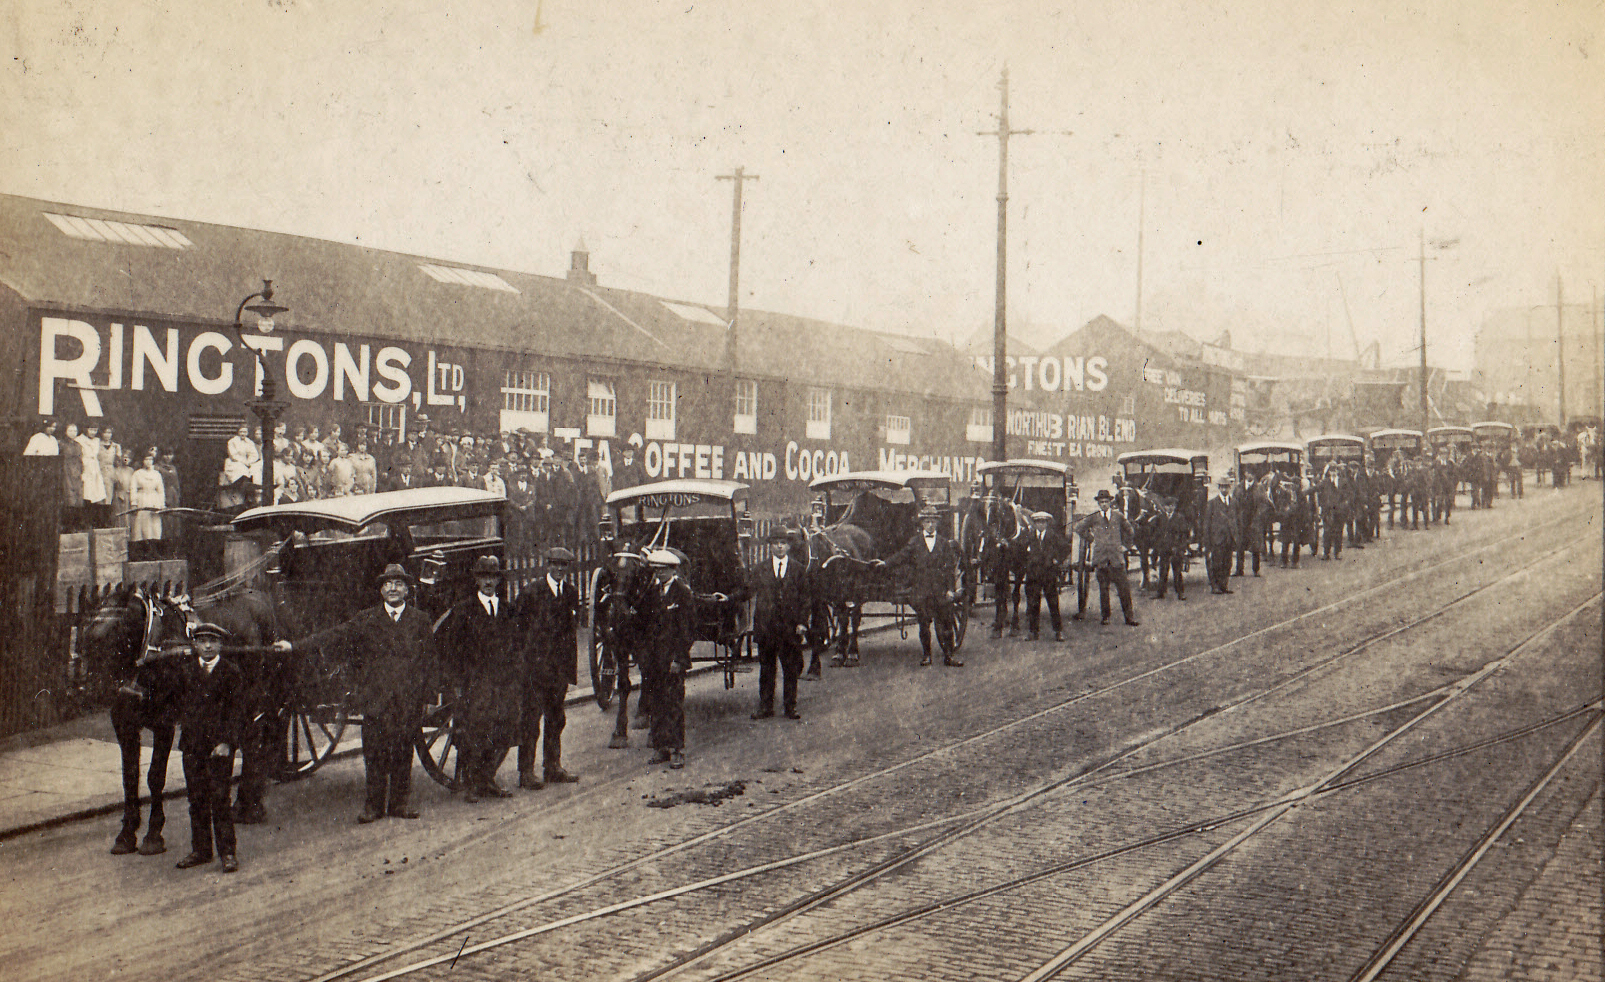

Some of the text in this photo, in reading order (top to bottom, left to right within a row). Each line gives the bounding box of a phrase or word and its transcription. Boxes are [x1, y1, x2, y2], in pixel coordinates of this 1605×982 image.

[733, 451, 777, 480] AND
[785, 440, 850, 481] COCOA
[638, 493, 700, 508] RINGTONS
